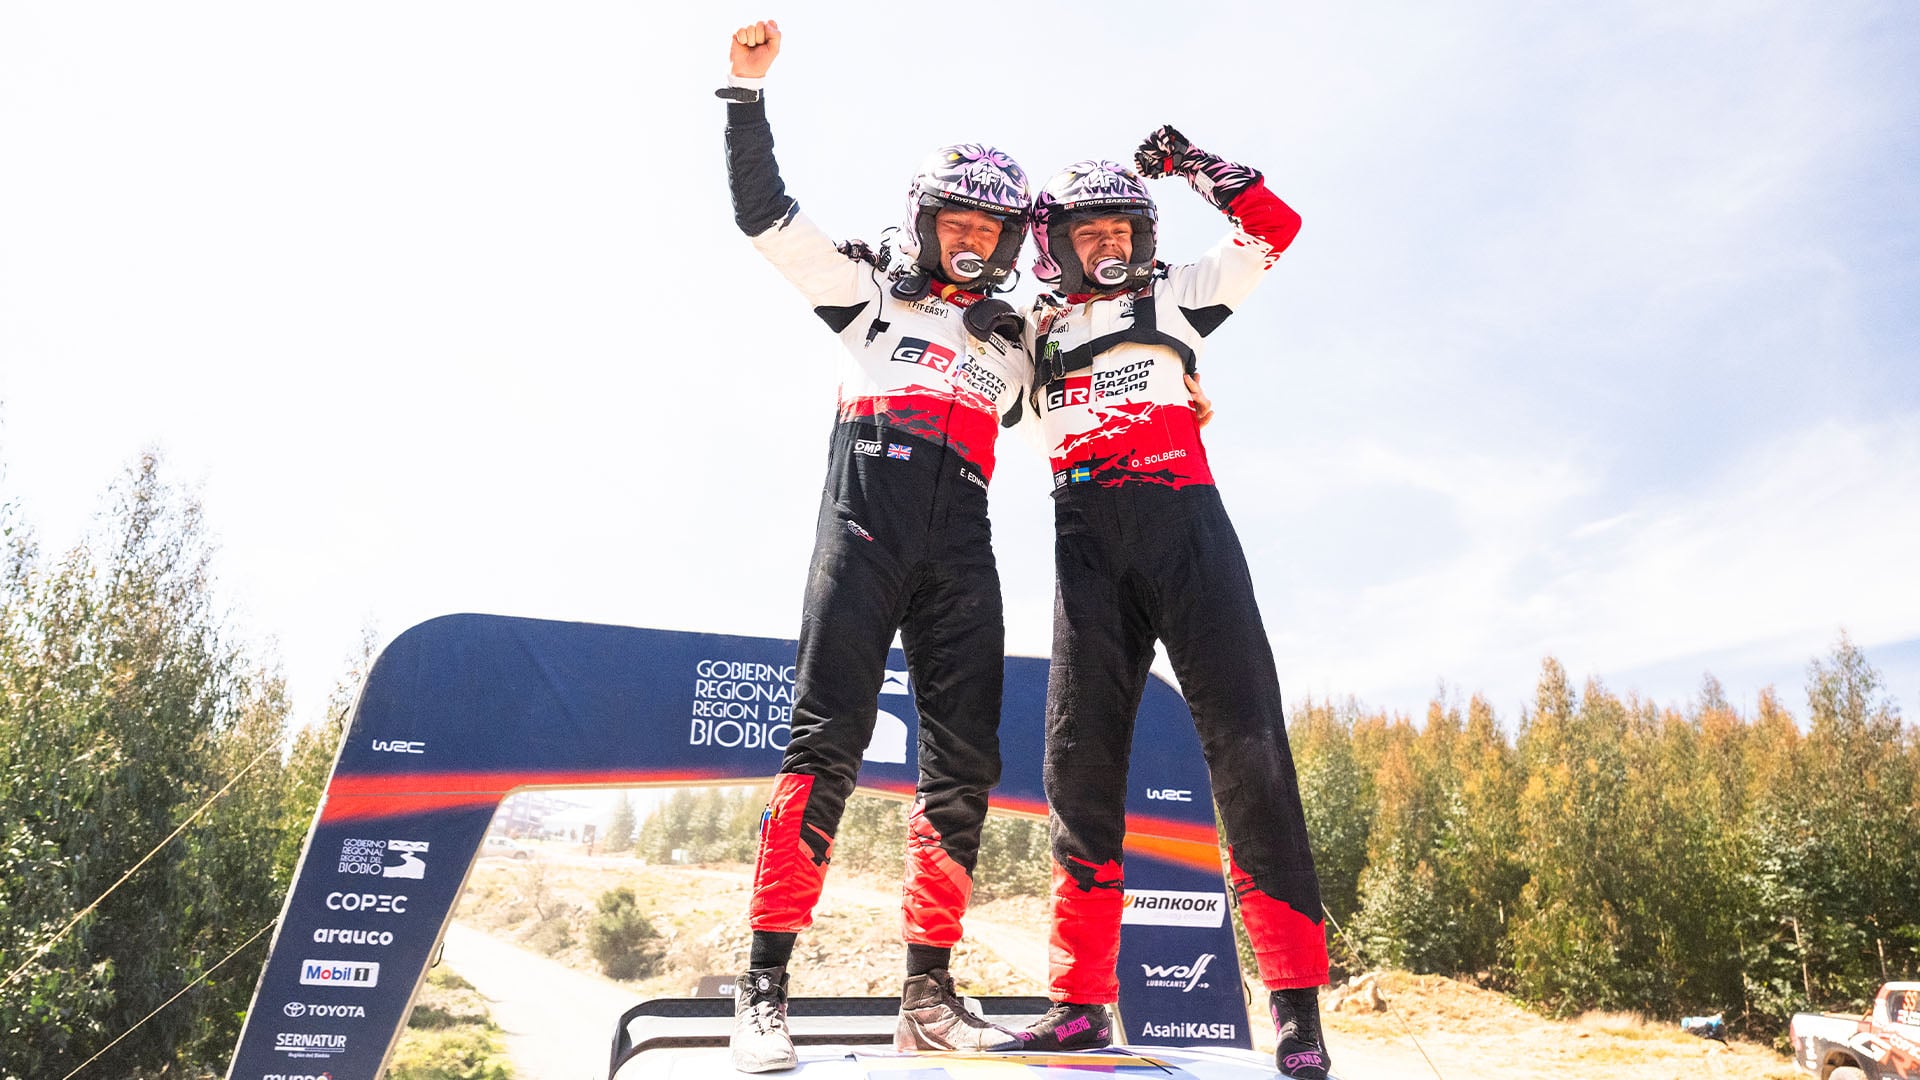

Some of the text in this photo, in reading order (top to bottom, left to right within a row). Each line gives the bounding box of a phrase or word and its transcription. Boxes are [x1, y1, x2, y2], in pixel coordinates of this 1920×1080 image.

[951, 194, 978, 205] TOYOTA
[979, 201, 1004, 211] GAZOO
[1076, 199, 1104, 208] TOYOTA
[893, 347, 950, 372] GR
[967, 354, 1008, 391] TOYOTA
[1093, 359, 1155, 380] TOYOTA
[961, 363, 1002, 394] GAZOO
[1094, 370, 1150, 391] GAZOO
[1048, 387, 1089, 411] GR
[1095, 380, 1148, 402] Racing
[855, 442, 882, 454] OMP
[1131, 449, 1187, 468] O. SOLBERG
[696, 660, 796, 684] GOBIERNO
[692, 700, 759, 720] REGION
[689, 718, 791, 751] BIOBIO
[372, 739, 425, 754] WRC
[1146, 788, 1192, 802] WRC
[341, 846, 384, 856] REGIONAL
[343, 838, 386, 849] GOBIERNO
[340, 854, 367, 863] REGION
[337, 862, 382, 875] BIOBIO
[326, 892, 408, 913] COPEC
[313, 928, 394, 946] arauco
[306, 965, 351, 980] Mobil
[1146, 980, 1187, 989] LUBRICANTS
[307, 1004, 365, 1018] TOYOTA
[1142, 1021, 1236, 1040] AsahiKASEI
[275, 1032, 347, 1048] SERNATUR
[1284, 1053, 1322, 1069] OMP
